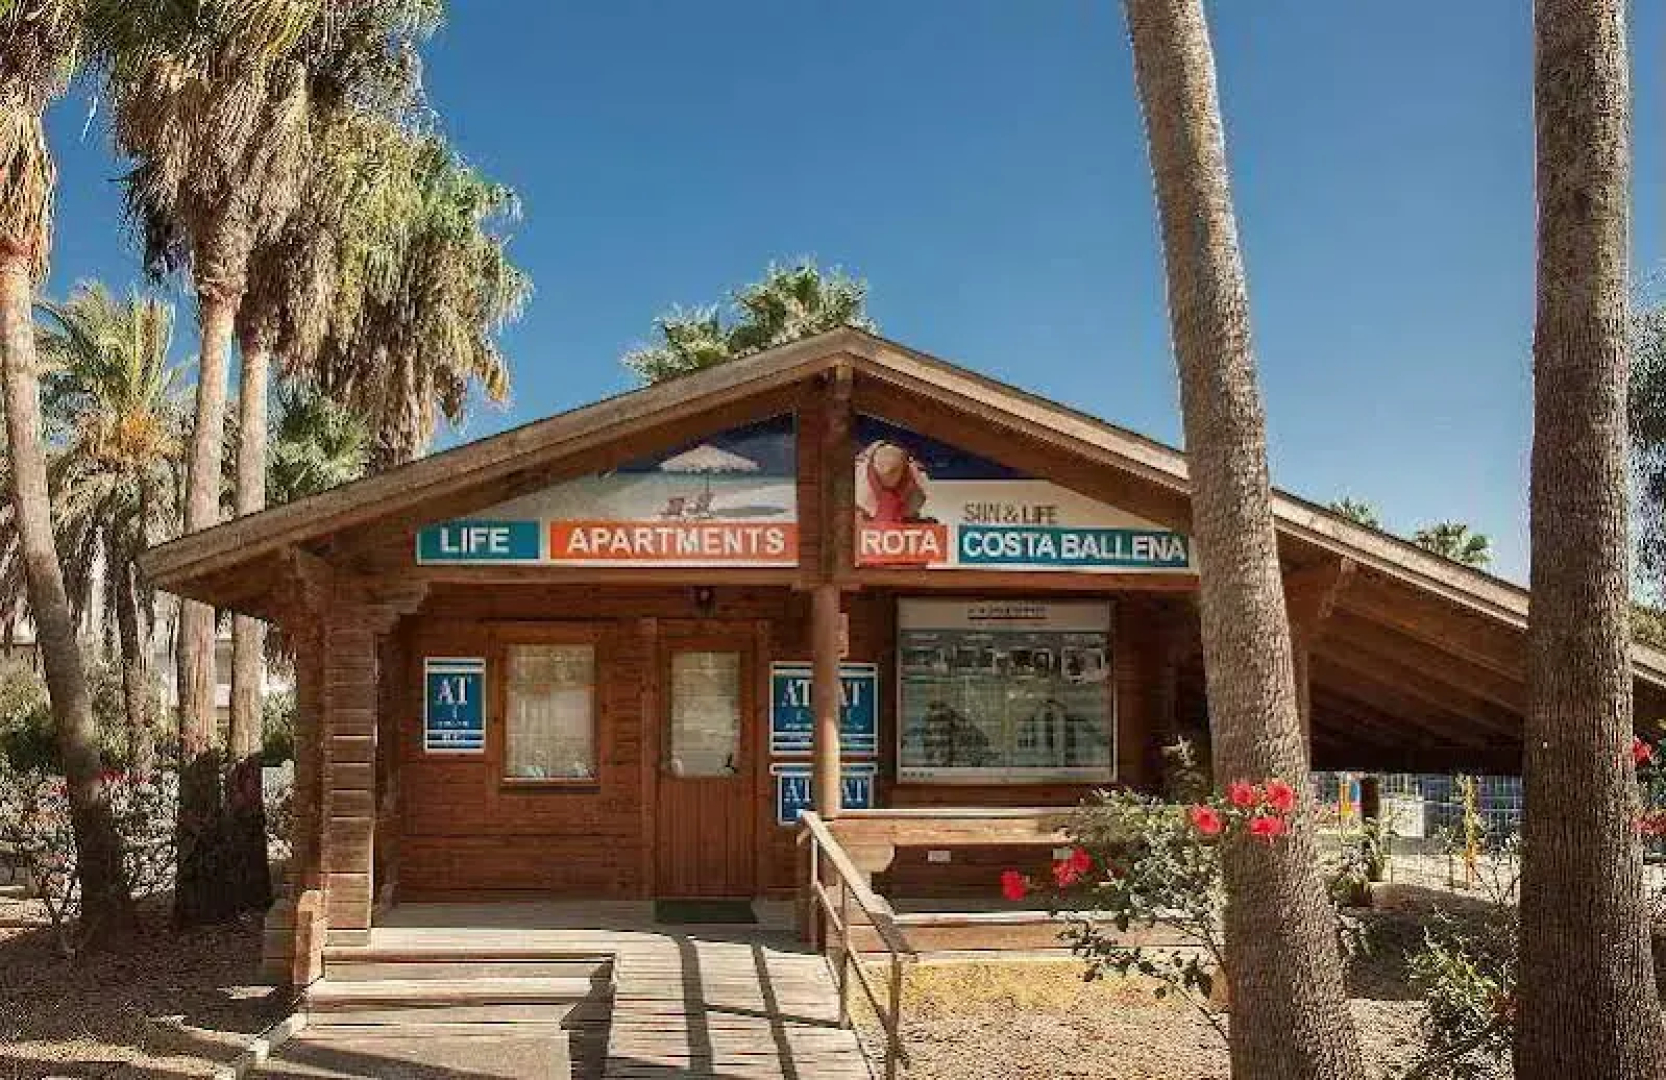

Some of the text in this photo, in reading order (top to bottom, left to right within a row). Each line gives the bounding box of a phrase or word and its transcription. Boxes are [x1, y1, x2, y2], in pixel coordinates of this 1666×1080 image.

[1003, 504, 1018, 523] &
[1021, 504, 1059, 525] LIFE
[440, 526, 510, 553] LIFE
[566, 527, 785, 555] APARTMENTS
[859, 529, 940, 556] ROTA
[962, 531, 1186, 561] COSTA BALLENA
